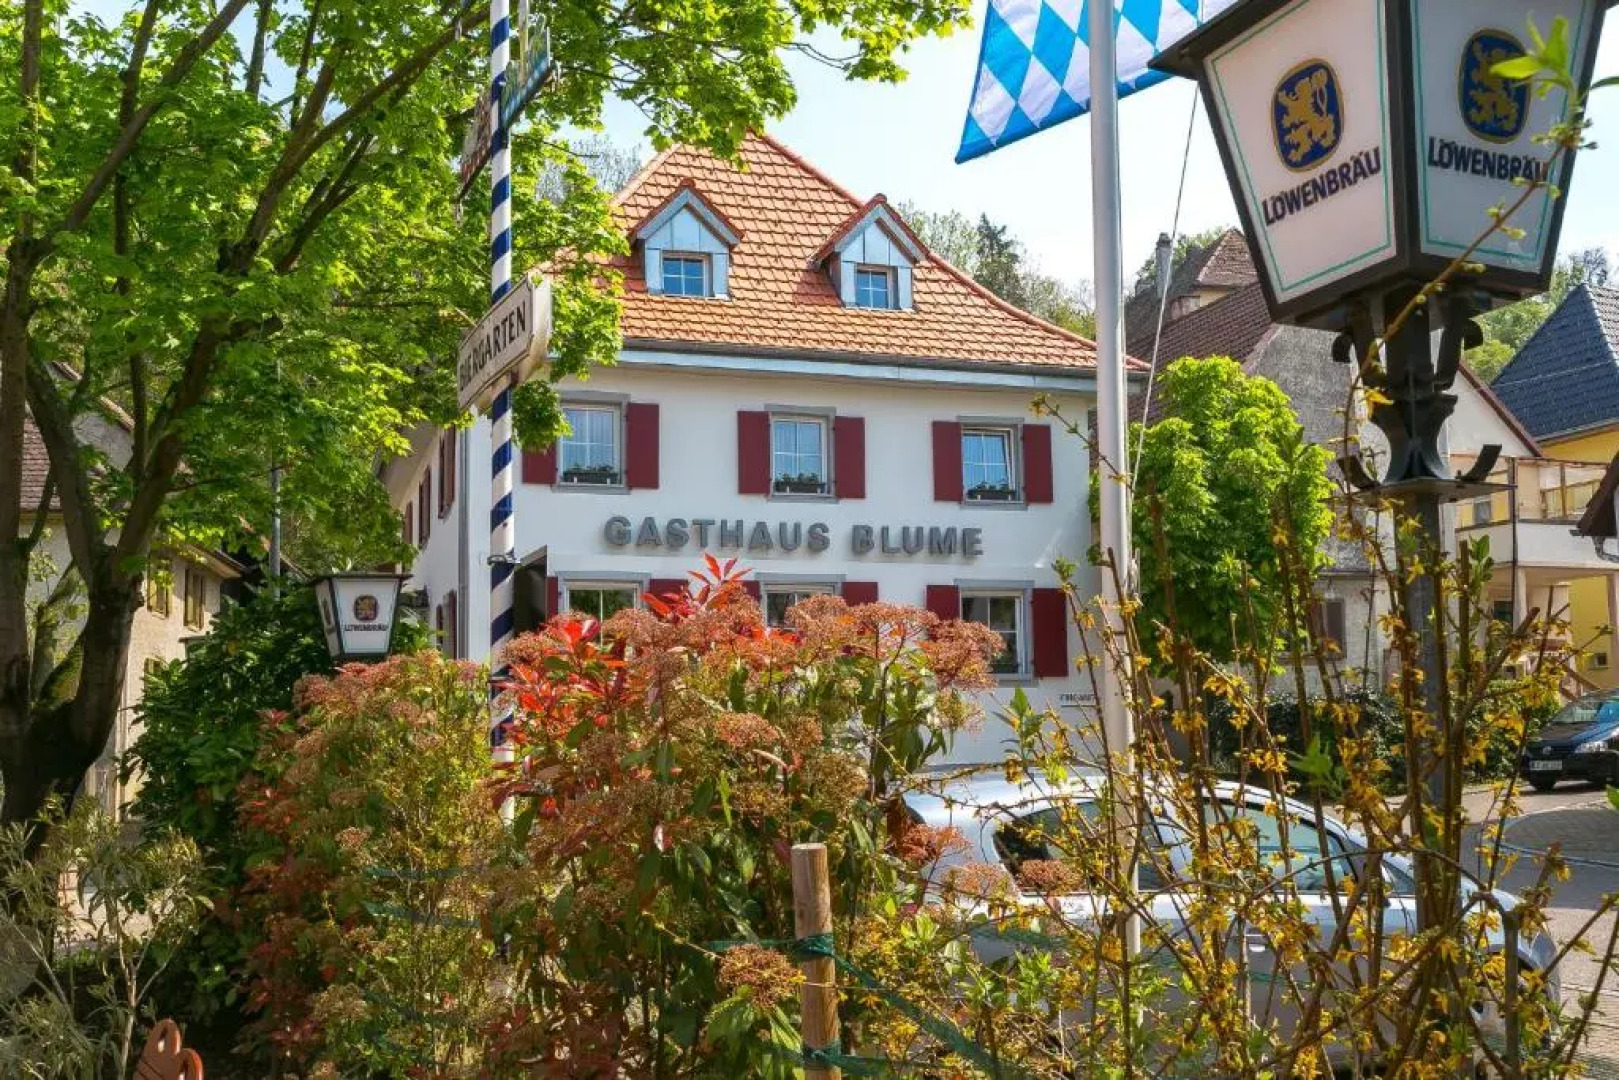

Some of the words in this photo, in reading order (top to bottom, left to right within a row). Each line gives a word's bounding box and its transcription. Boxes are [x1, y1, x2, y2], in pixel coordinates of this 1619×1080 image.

[1261, 146, 1382, 226] LÖWENBRÄU
[460, 301, 526, 392] BIERGARTEN
[603, 516, 831, 552] GASTHAUS
[851, 524, 984, 558] BLUME
